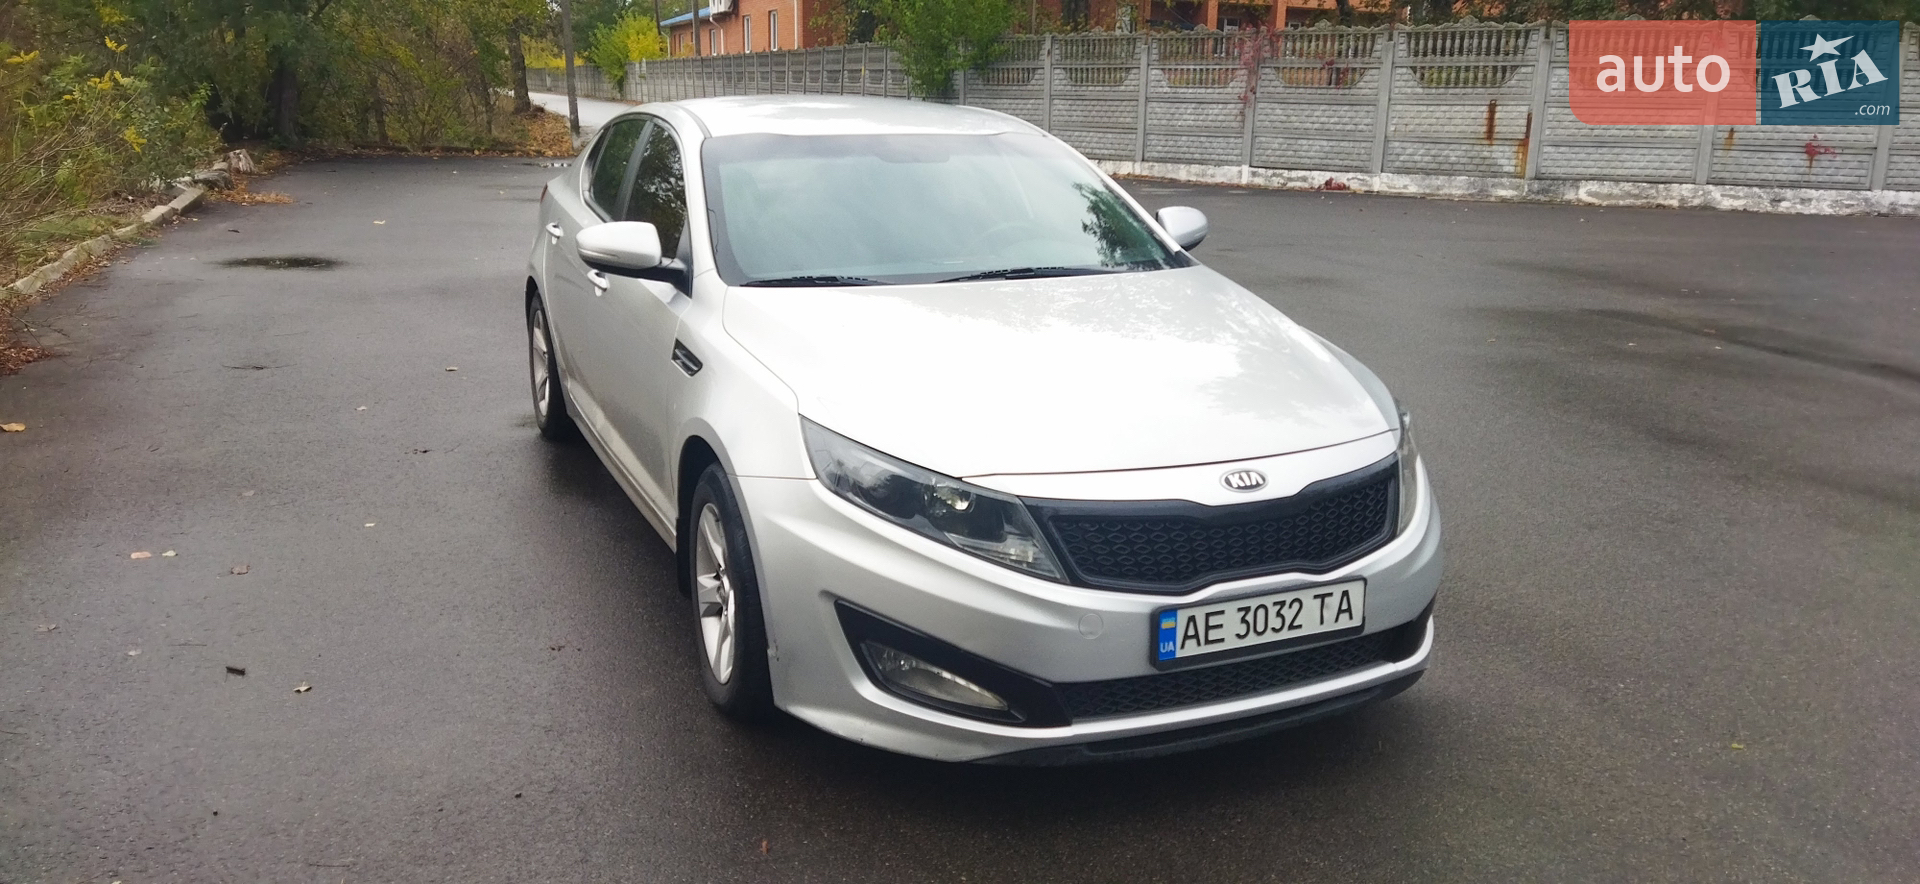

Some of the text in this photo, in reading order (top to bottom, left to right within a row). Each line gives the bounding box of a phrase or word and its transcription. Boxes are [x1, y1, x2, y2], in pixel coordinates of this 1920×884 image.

[1228, 471, 1264, 489] KIA
[1180, 590, 1354, 650] AE 3032 TA
[1160, 642, 1175, 653] UA
